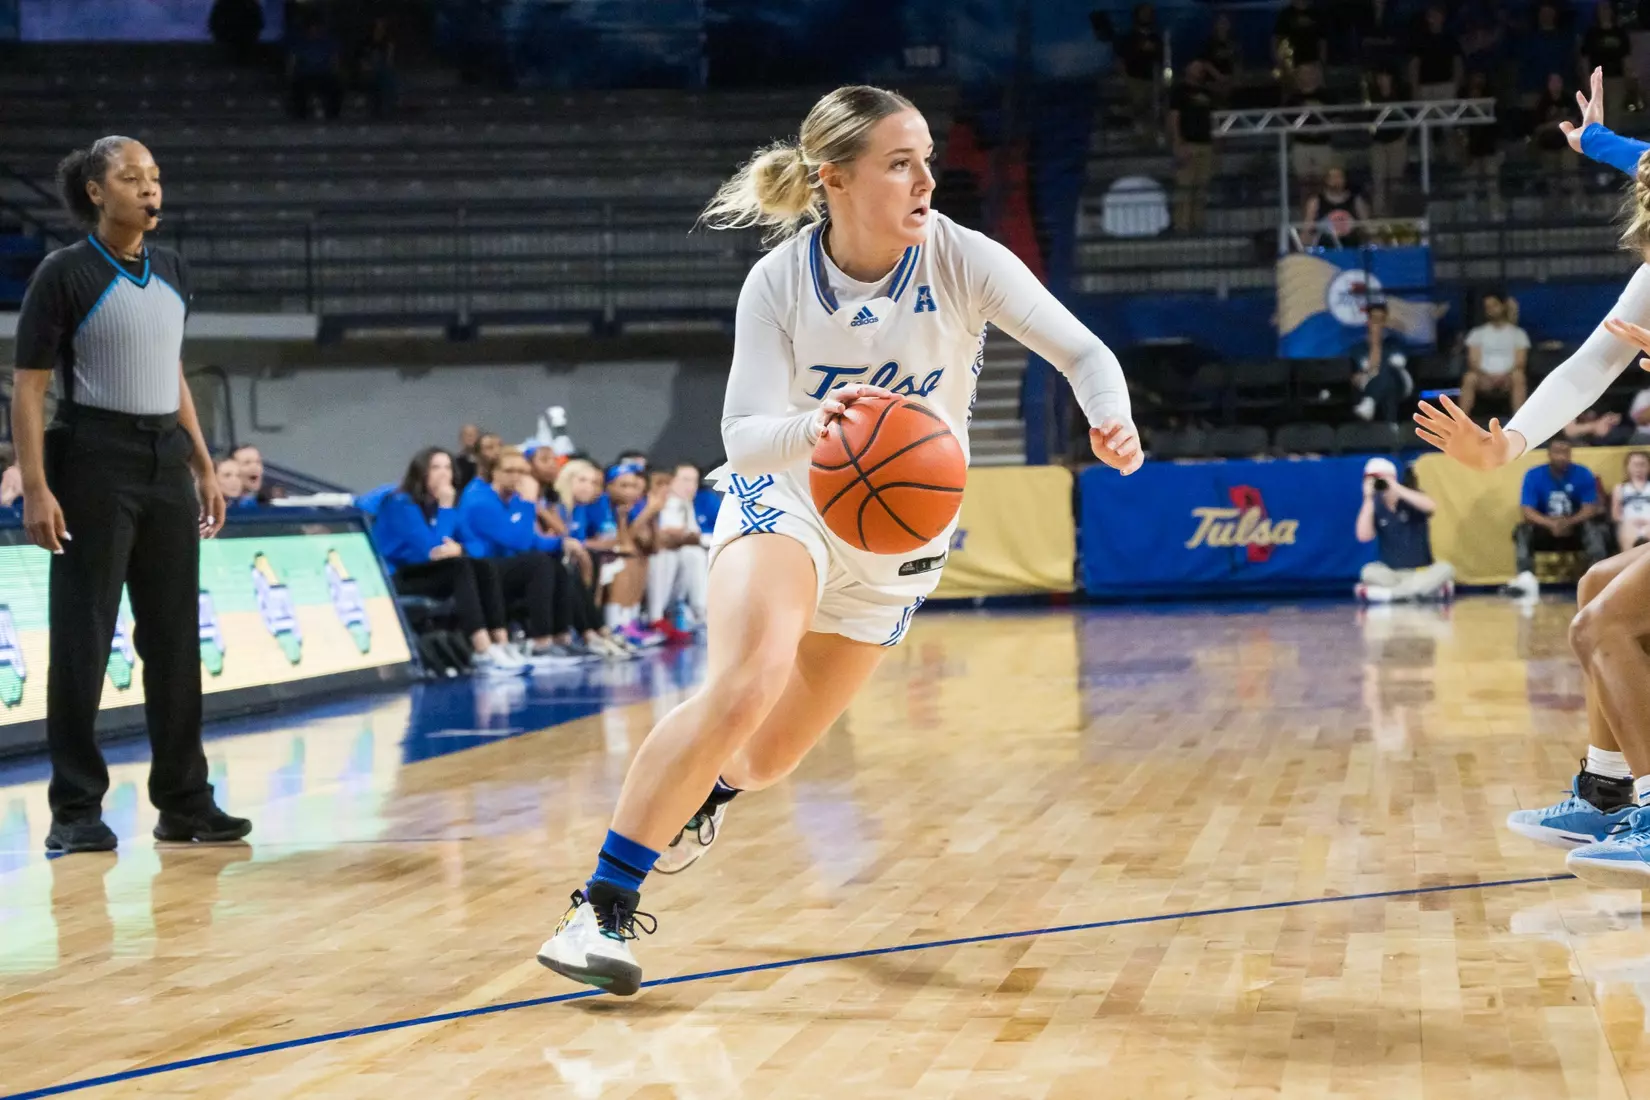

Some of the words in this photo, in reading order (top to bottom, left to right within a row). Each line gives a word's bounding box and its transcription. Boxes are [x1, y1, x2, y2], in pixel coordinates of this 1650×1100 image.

[851, 317, 879, 327] adidas
[804, 360, 945, 400] Tlsa
[1185, 506, 1299, 549] Tulsa
